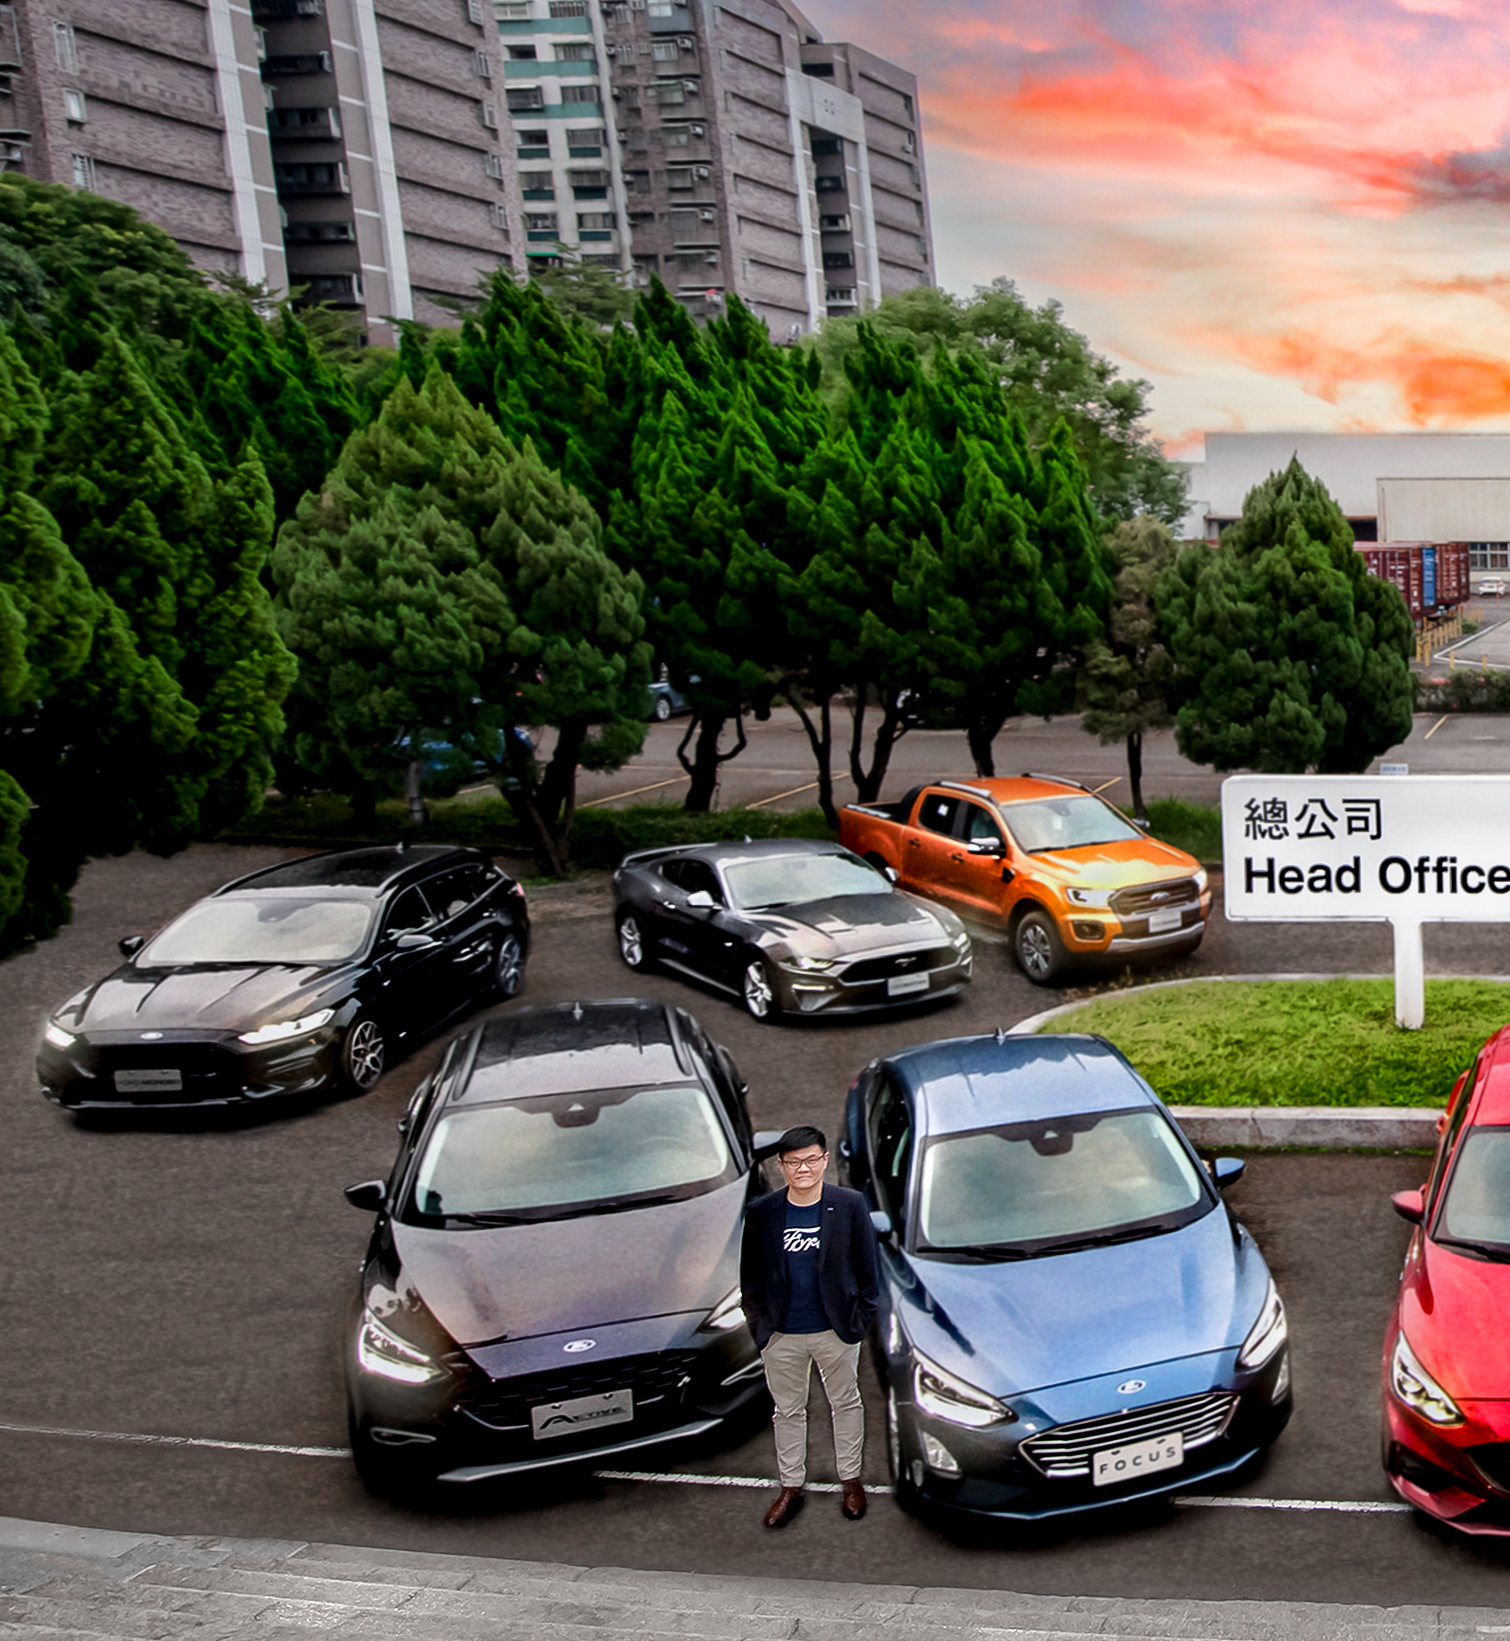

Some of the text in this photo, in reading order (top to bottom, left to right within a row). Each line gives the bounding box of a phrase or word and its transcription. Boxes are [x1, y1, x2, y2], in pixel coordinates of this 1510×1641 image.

[1244, 797, 1382, 841] 總公司
[1244, 855, 1361, 894] Head
[783, 1226, 822, 1252] For
[1099, 1446, 1177, 1475] FOCUS
